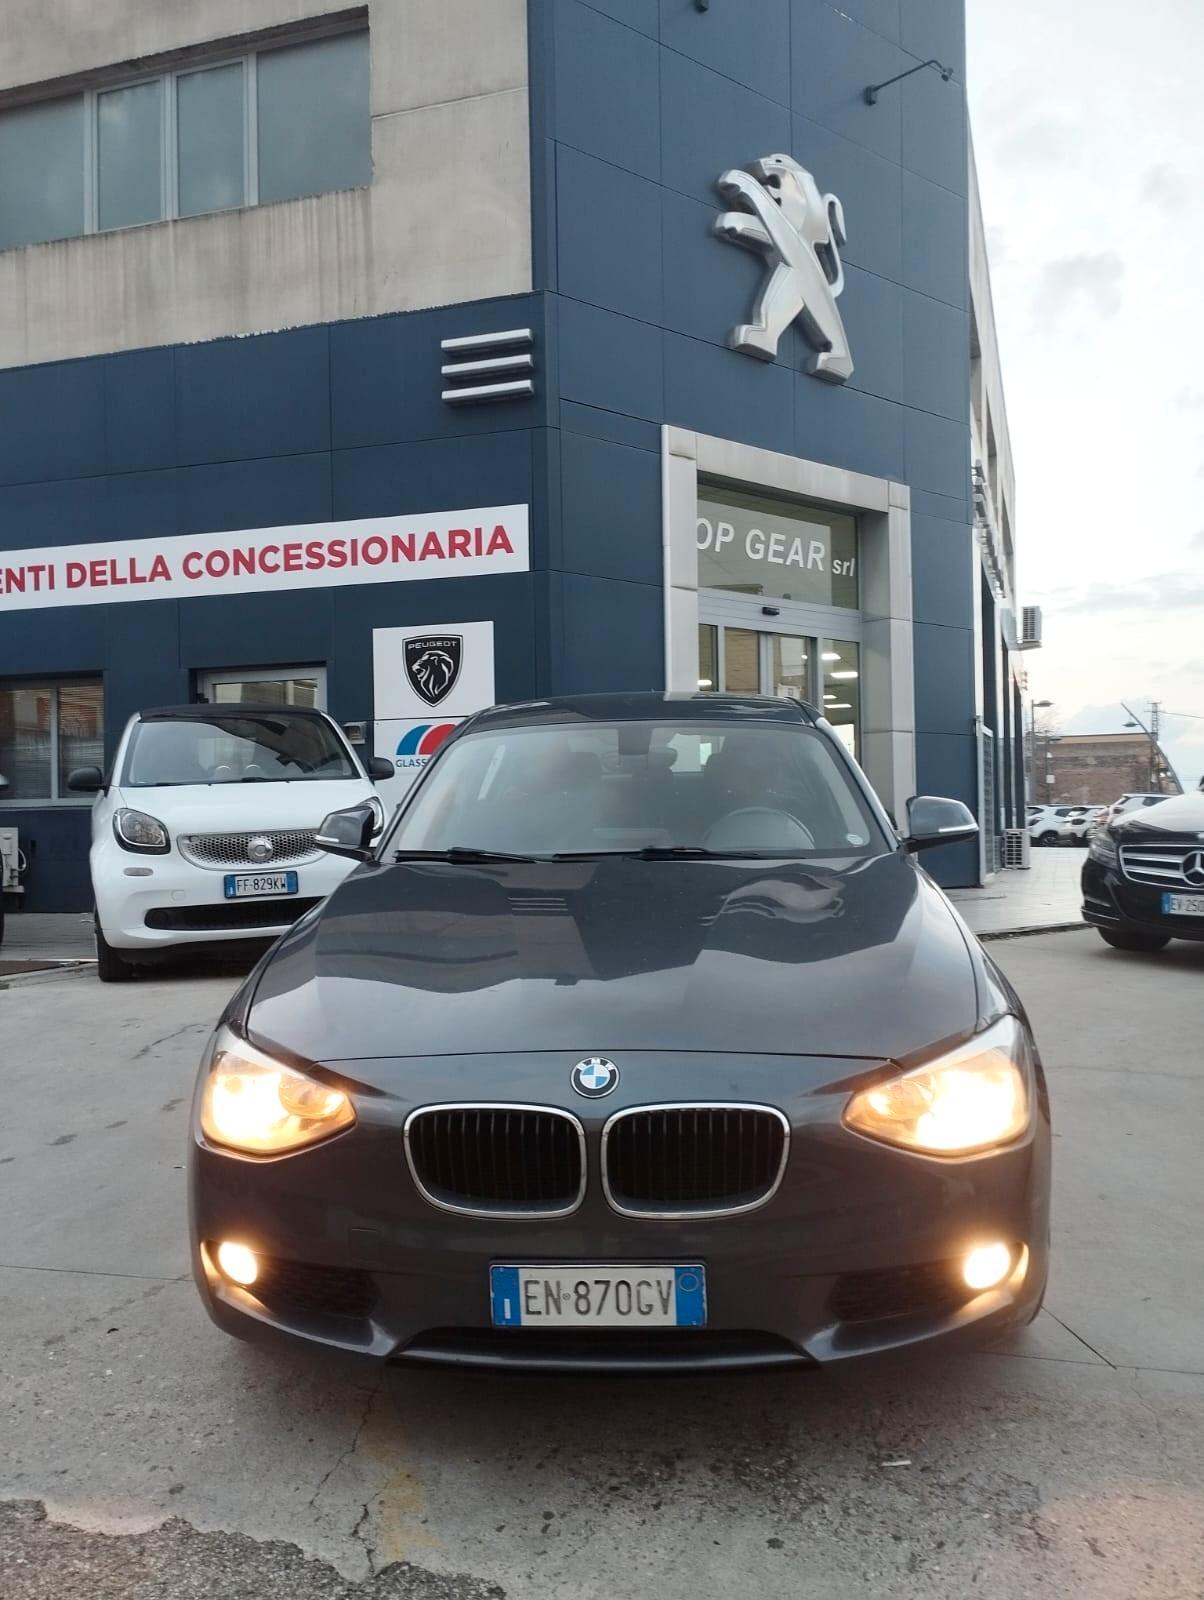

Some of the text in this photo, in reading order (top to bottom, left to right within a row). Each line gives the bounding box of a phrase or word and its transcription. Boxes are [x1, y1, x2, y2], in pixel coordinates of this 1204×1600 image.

[0, 525, 515, 594] NTI DELLA CONCESSIONARIA
[745, 529, 826, 571] GEAR
[832, 558, 855, 577] srl
[408, 640, 457, 650] PEUGEOT
